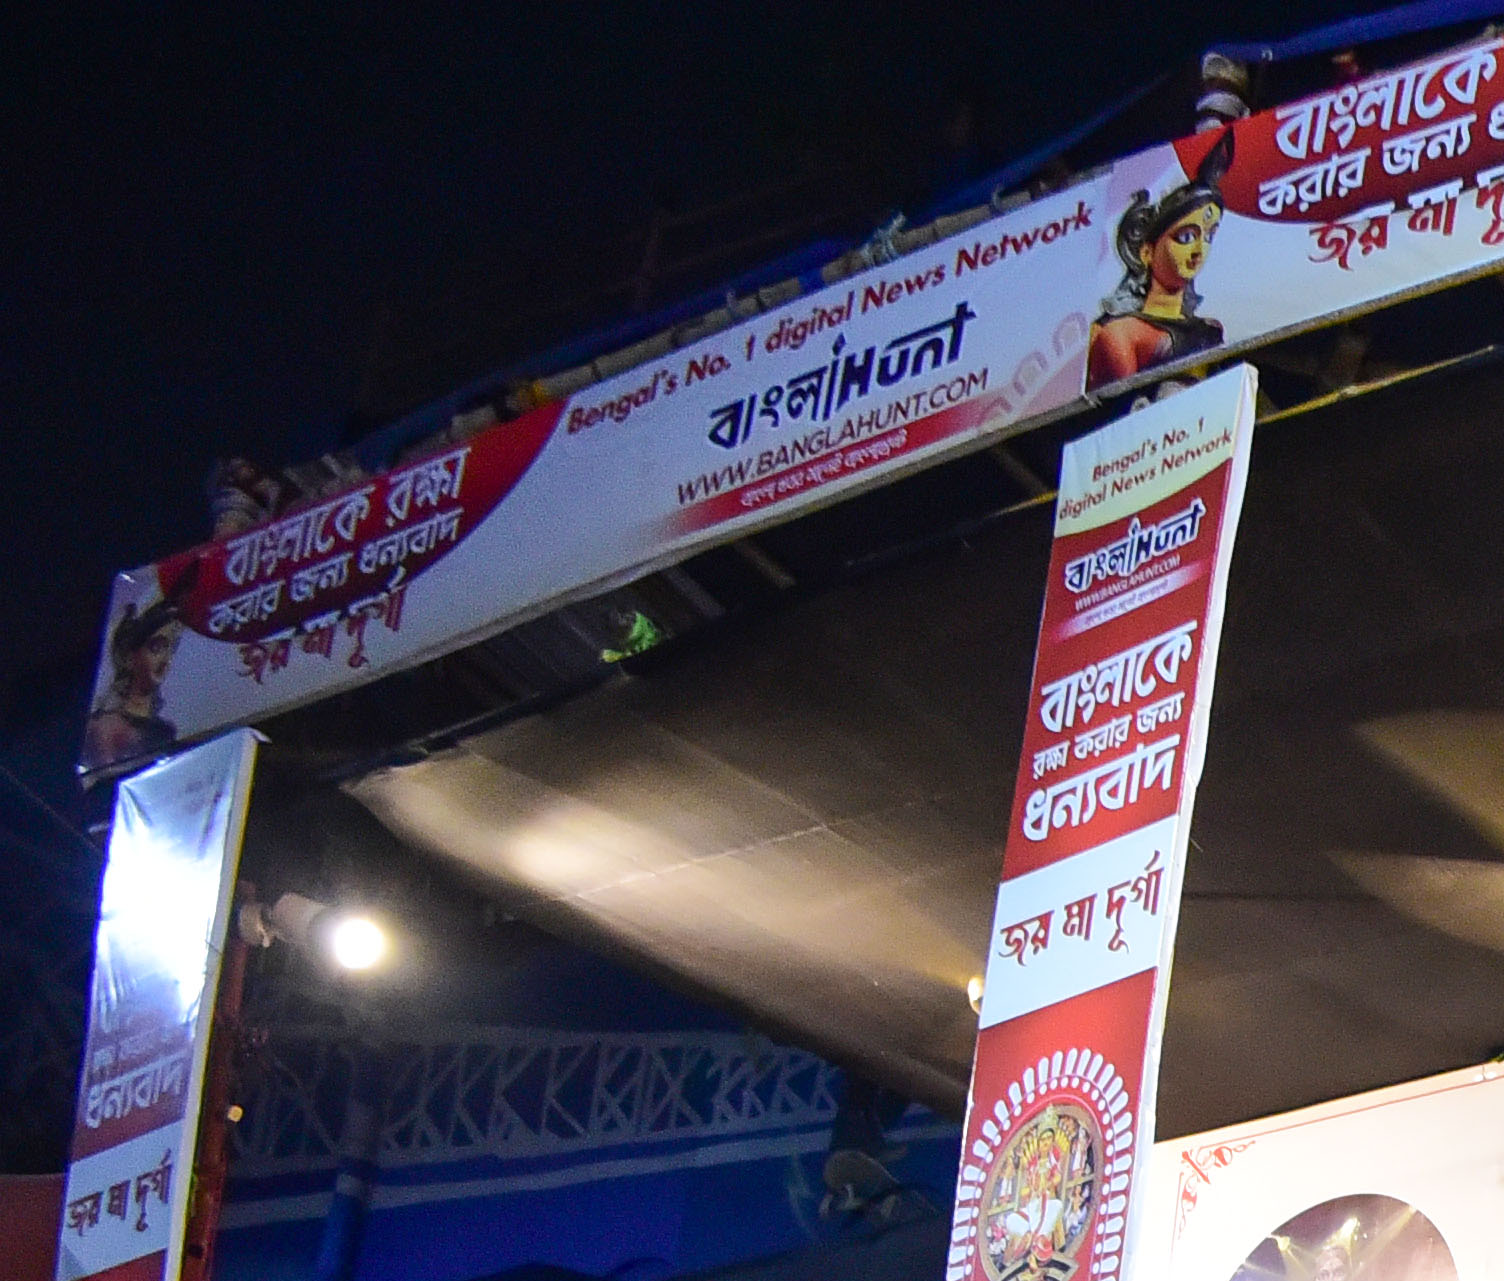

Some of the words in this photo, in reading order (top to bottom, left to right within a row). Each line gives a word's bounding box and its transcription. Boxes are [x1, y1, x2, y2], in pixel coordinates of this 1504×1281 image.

[1275, 40, 1504, 159] বাংলাকে
[1257, 149, 1370, 217] করার
[1382, 113, 1477, 176] জন্য
[1406, 178, 1462, 235] মা
[567, 368, 676, 436] Bengal's
[684, 350, 732, 392] No.
[745, 338, 755, 363] 1
[765, 292, 852, 354] digital
[861, 264, 946, 314] News
[955, 201, 1094, 278] Network
[676, 368, 989, 504] WWW.BANGLAHUNT.COM
[1059, 484, 1107, 522] digital
[1111, 466, 1156, 498] News
[1160, 428, 1233, 470] Network
[1092, 440, 1157, 483] Bengal's
[1162, 429, 1190, 448] No.
[208, 580, 284, 634] করার
[291, 553, 351, 602] জন্য
[359, 509, 465, 575] ধন্যবাদ
[225, 487, 374, 586] বাংলাকে
[1040, 619, 1198, 733] বাংলাকে
[1022, 734, 1181, 841] ধন্যবাদ
[1032, 741, 1069, 780] রক্ষা
[1074, 714, 1132, 761] করার
[1136, 691, 1186, 734] জন্য
[1062, 893, 1098, 941] মা
